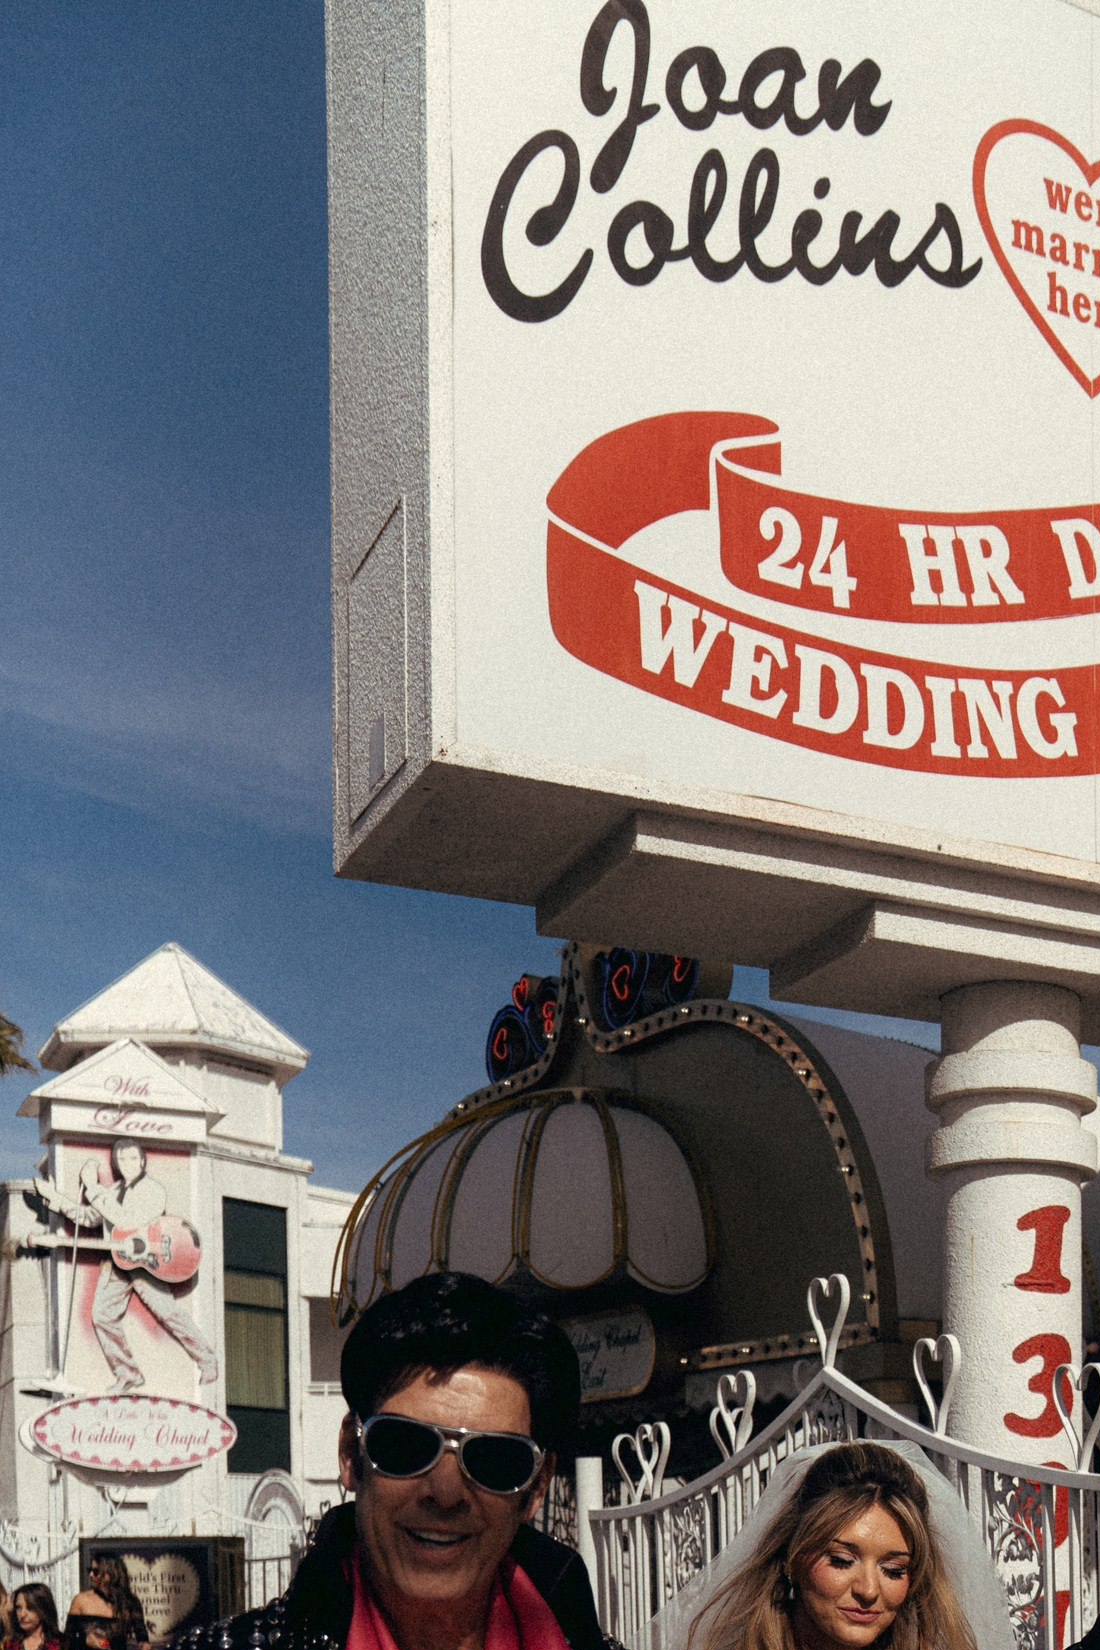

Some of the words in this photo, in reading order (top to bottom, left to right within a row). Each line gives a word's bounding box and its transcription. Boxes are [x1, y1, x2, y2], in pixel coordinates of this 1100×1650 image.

[581, 0, 893, 194] Joan
[481, 130, 983, 323] Collins
[757, 506, 858, 609] 24
[898, 523, 1026, 607] HR
[633, 580, 1079, 760] WEDDING
[104, 1075, 151, 1097] With
[90, 1106, 174, 1134] Love
[56, 1422, 136, 1451] Wedding
[143, 1423, 210, 1452] Chapel
[128, 1572, 157, 1584] orld's
[160, 1572, 186, 1584] First
[145, 1606, 171, 1617] Love
